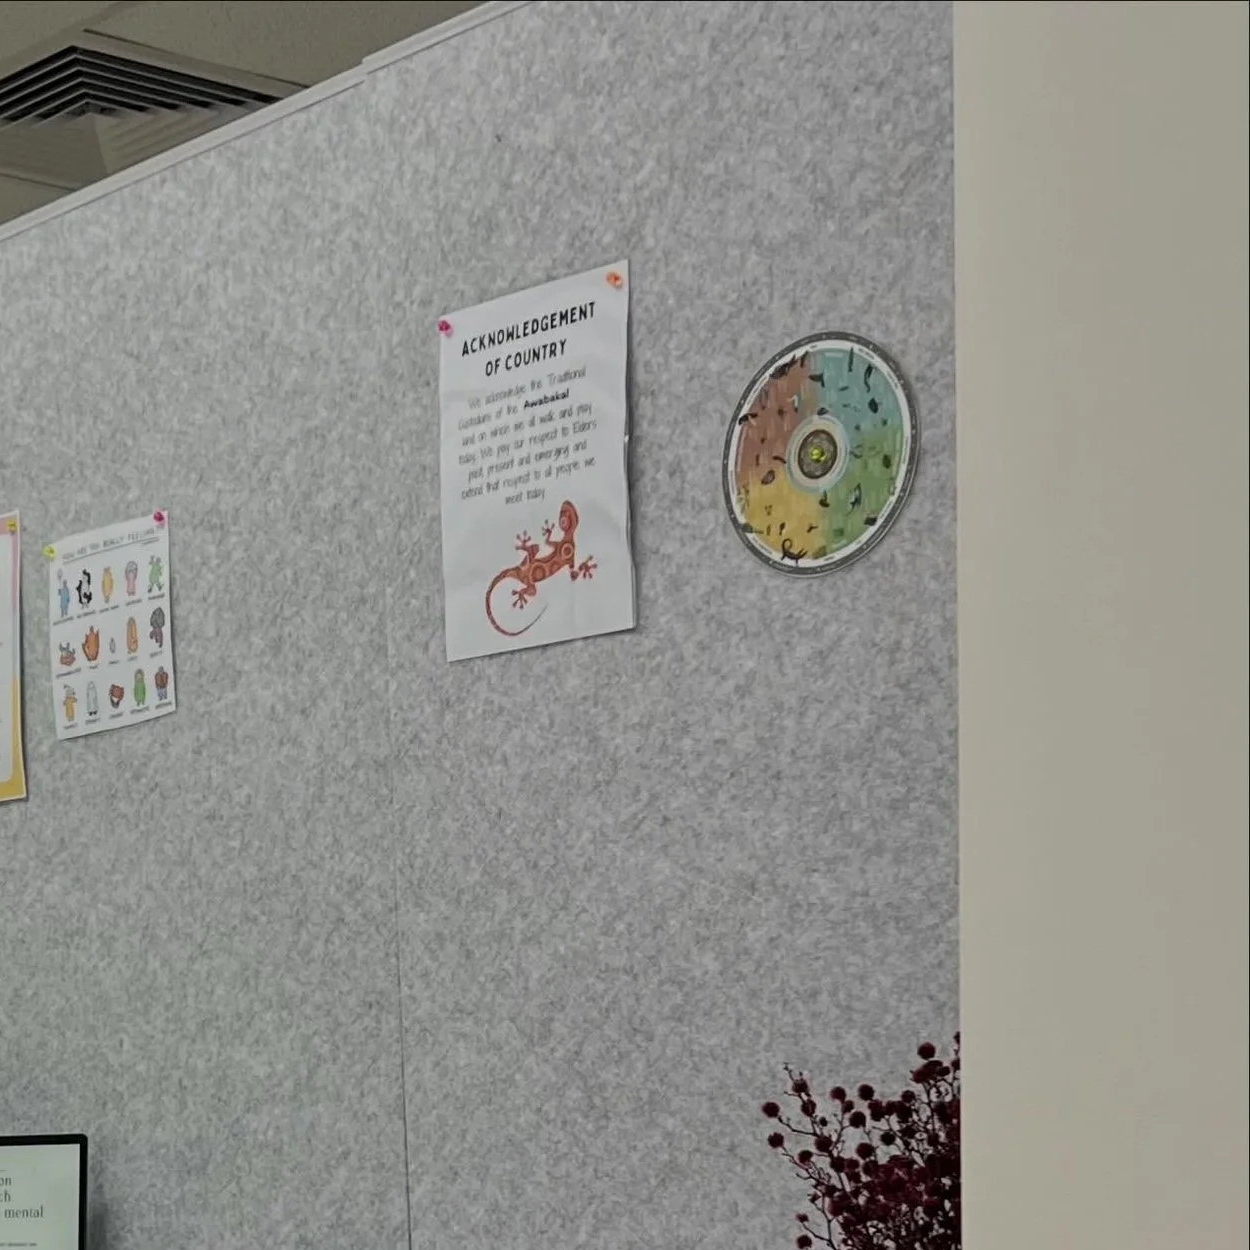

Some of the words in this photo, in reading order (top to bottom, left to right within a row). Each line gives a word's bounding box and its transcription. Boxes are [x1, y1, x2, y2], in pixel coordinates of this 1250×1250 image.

[461, 301, 596, 357] ACKNOWLEDGEMENT
[485, 358, 500, 377] OF
[505, 338, 568, 371] COUNTRY
[524, 388, 569, 410] Awabakal
[4, 1205, 45, 1219] mental
